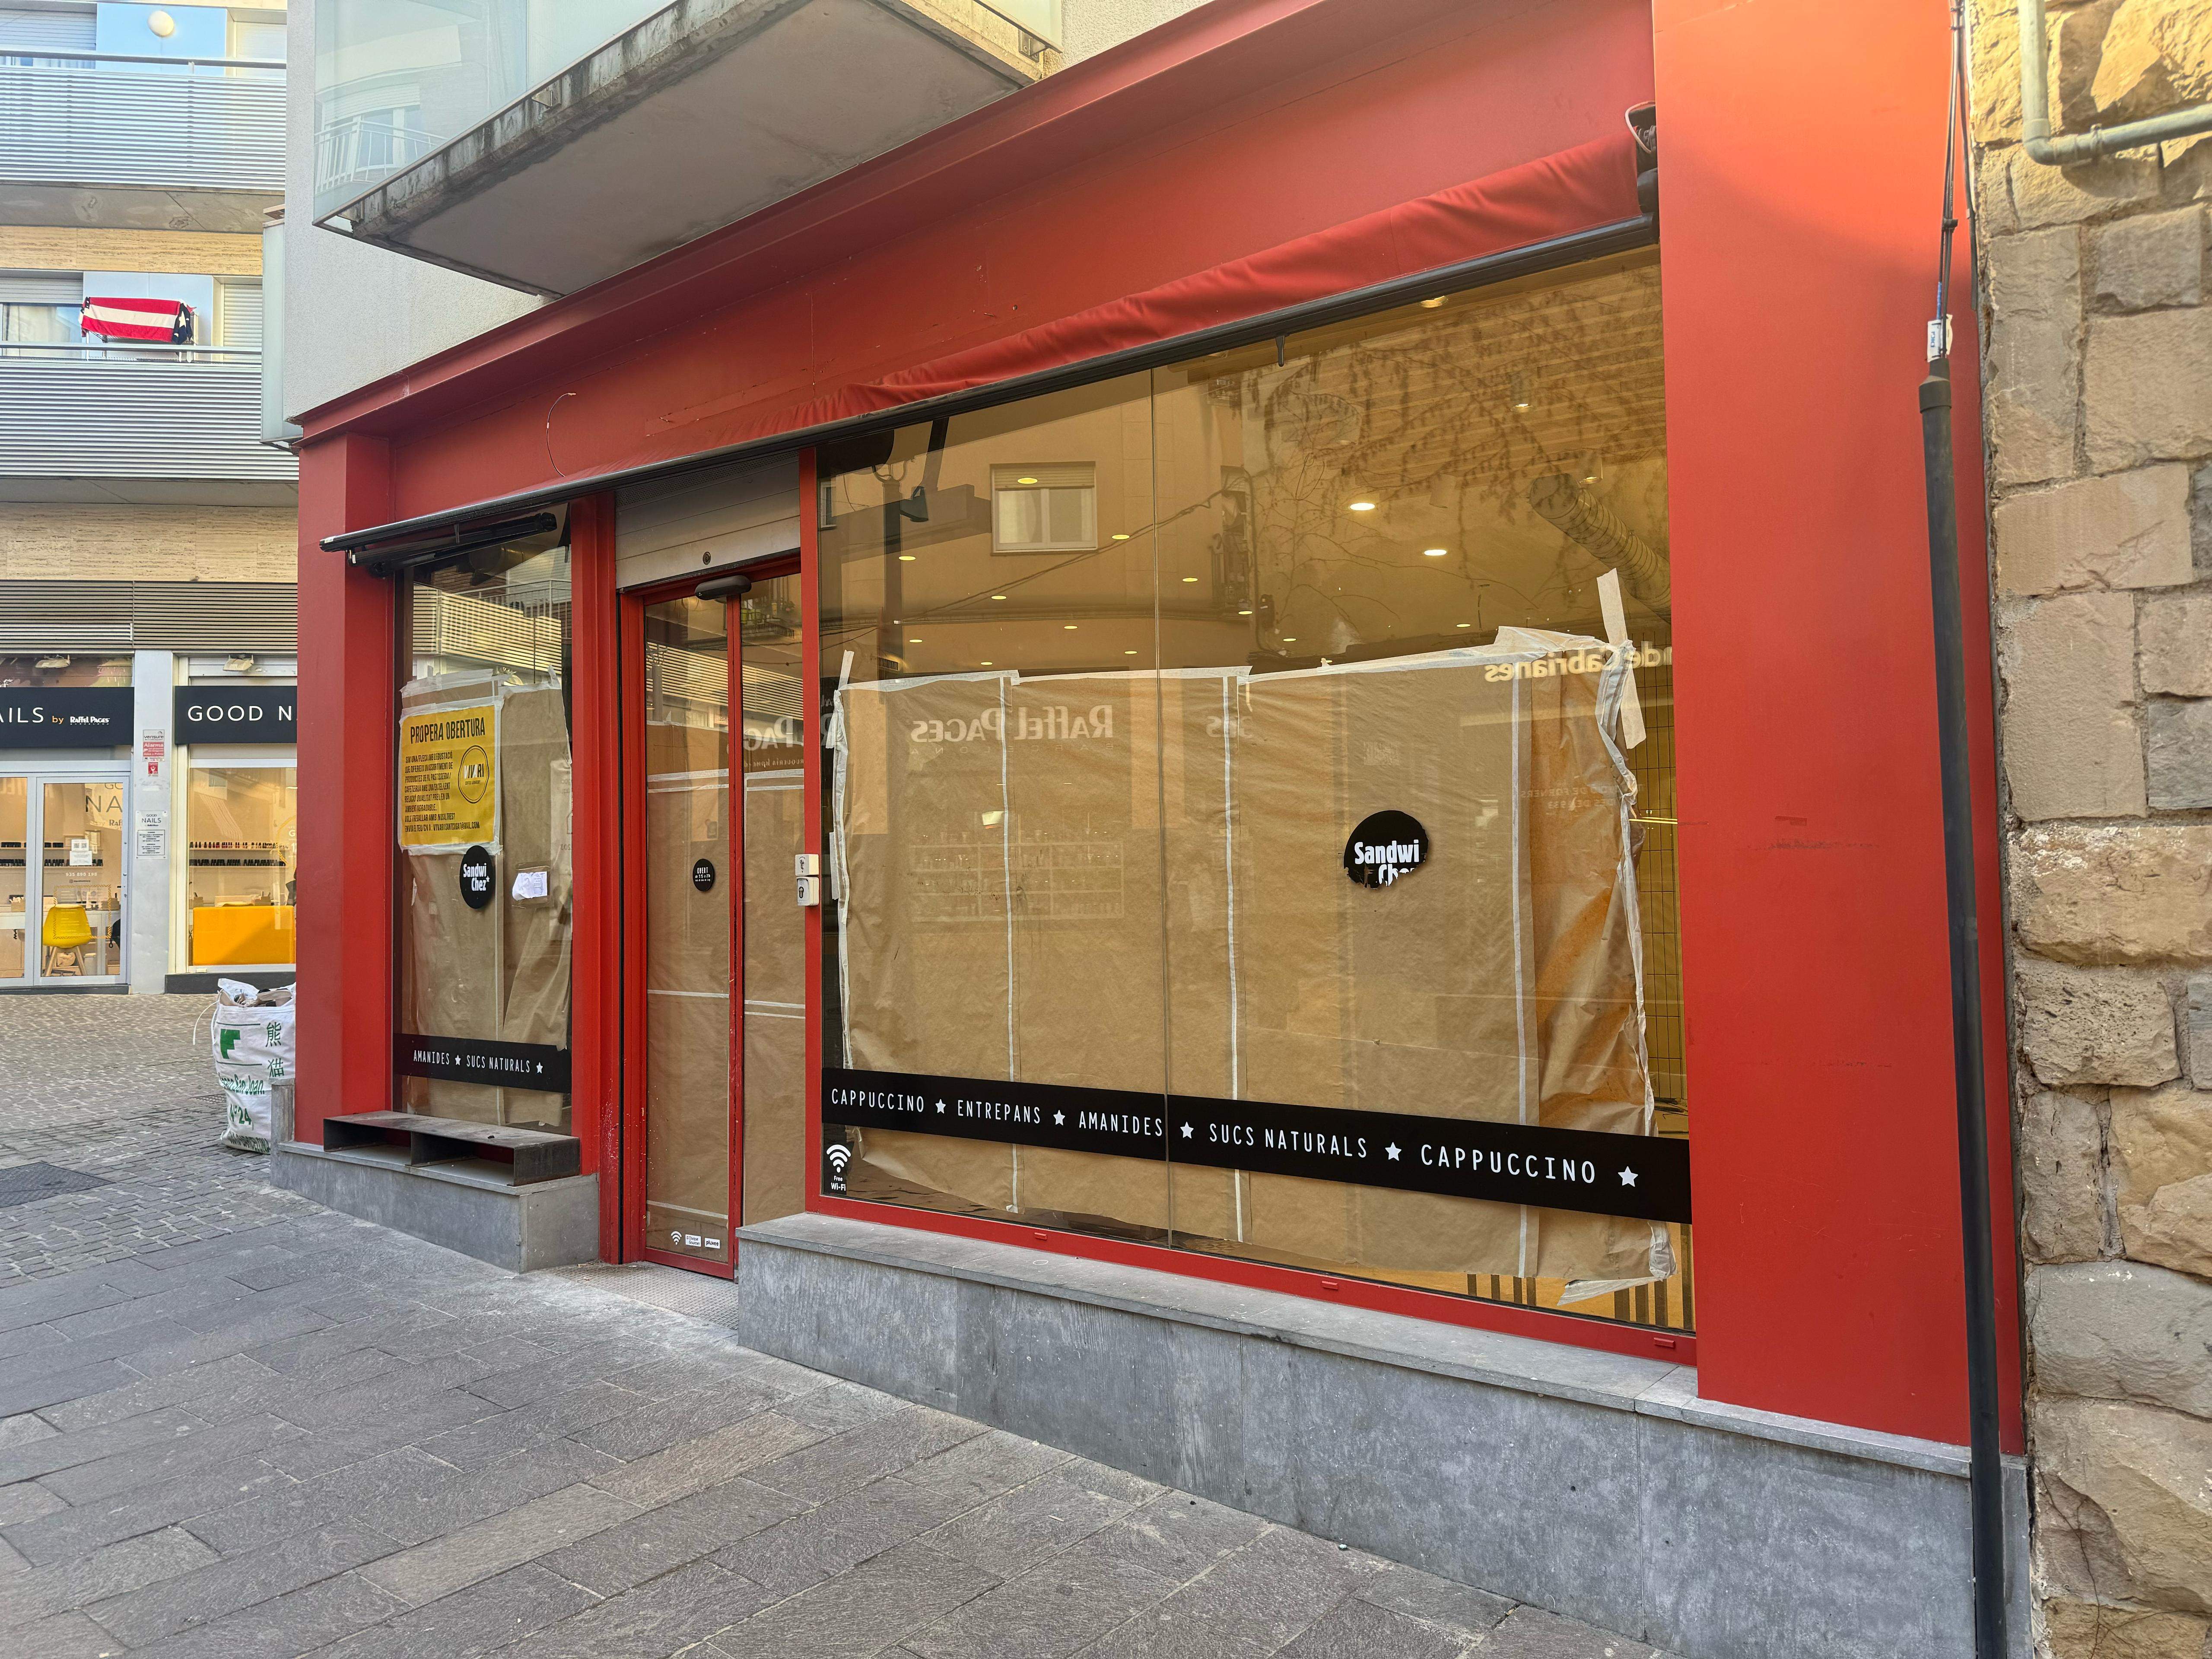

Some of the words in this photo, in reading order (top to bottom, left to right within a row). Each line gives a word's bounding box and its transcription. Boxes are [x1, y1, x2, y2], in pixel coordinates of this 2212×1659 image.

[52, 715, 64, 725] by
[188, 705, 263, 721] GOOD
[410, 723, 443, 744] PROPERA
[446, 717, 485, 740] OBERTURA
[464, 763, 484, 779] VIVARI
[1354, 839, 1419, 864] Sandwi
[463, 863, 486, 877] Sandwi
[471, 877, 486, 891] Chez
[413, 1050, 449, 1065] AMANIDES
[467, 1055, 485, 1068] SUCS
[489, 1057, 530, 1073] NATURALS
[832, 1089, 923, 1112] CAPPUCCINO
[958, 1100, 1039, 1123] ENTREPANS
[1079, 1111, 1162, 1136] AMANIDES
[1210, 1124, 1253, 1145] SUCS
[1265, 1129, 1366, 1157] NATURALS
[1421, 1144, 1594, 1183] CAPPUCCINO
[831, 1182, 846, 1191] Wi-Fi
